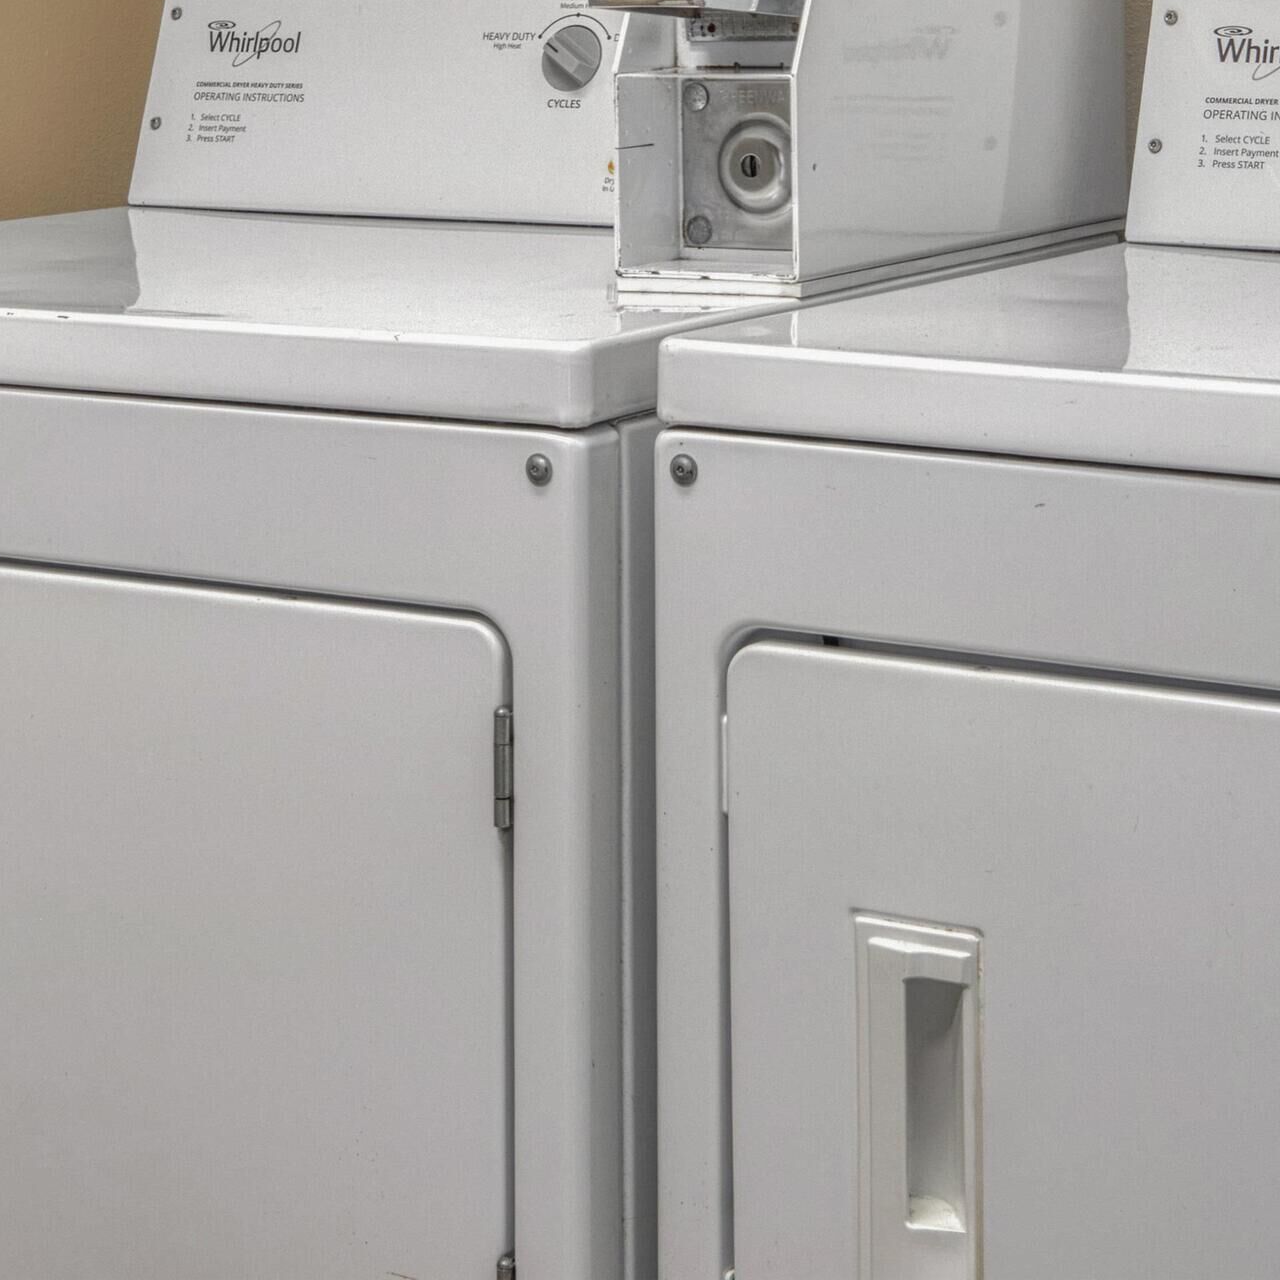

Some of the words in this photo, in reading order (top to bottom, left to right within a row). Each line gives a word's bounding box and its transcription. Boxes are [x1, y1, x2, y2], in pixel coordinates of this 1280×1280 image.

[482, 32, 511, 41] HEAVY
[511, 32, 536, 41] DUTY
[209, 31, 301, 60] Whirlpool
[193, 91, 241, 102] OPERATING
[242, 92, 305, 103] INSTRUCTIONS
[1205, 96, 1253, 105] COMMERCIAL
[1254, 97, 1279, 105] DRYER
[547, 99, 581, 109] CYCLES
[200, 113, 220, 121] Select
[221, 114, 241, 122] CYCLE
[1203, 109, 1268, 121] OPERATING
[198, 124, 218, 132] Insert
[218, 125, 247, 134] Payment
[197, 134, 214, 142] Press
[215, 135, 235, 143] START
[1201, 134, 1208, 143] 1.
[1215, 134, 1241, 144] Select
[1242, 135, 1271, 145] CYCLE
[1199, 146, 1207, 156] 2.
[1213, 147, 1239, 156] Insert
[1240, 148, 1279, 159] Payment
[1197, 159, 1205, 168] 3.
[1212, 159, 1236, 169] Press
[1238, 160, 1265, 169] START
